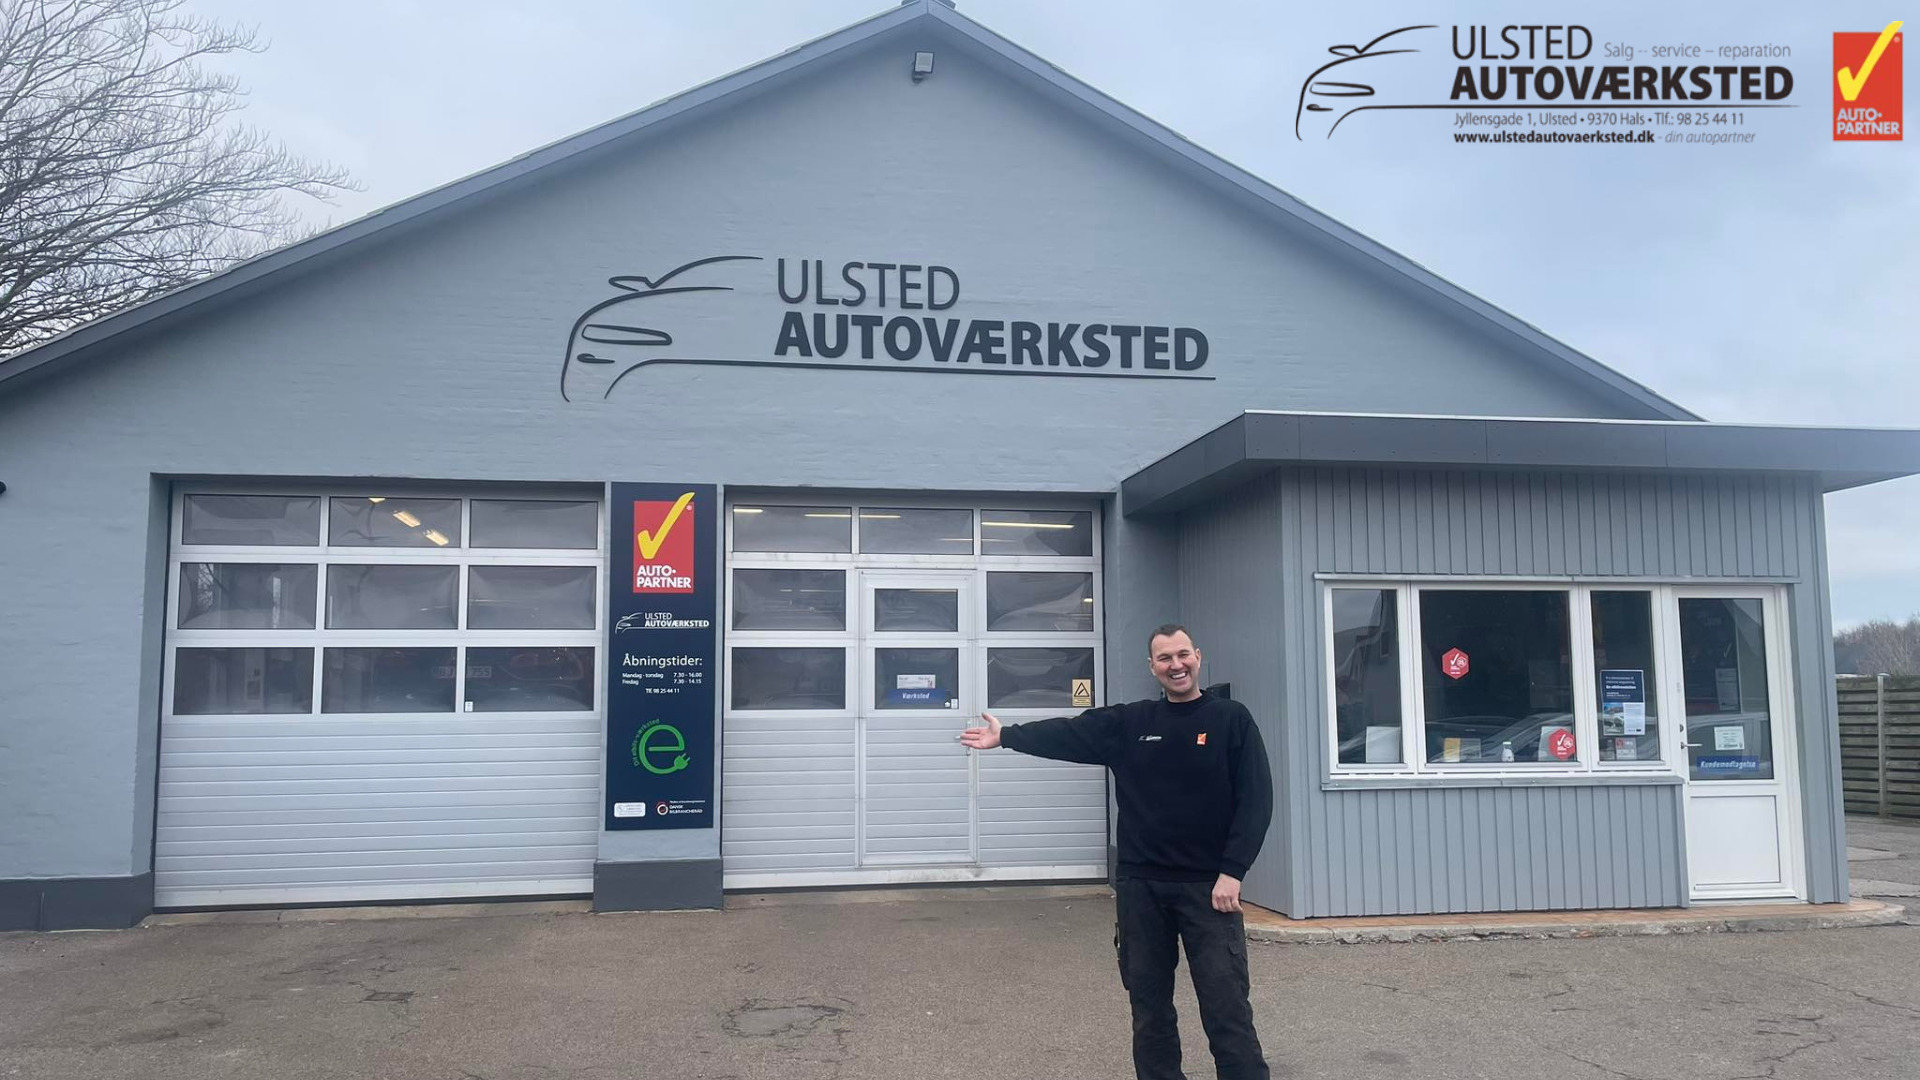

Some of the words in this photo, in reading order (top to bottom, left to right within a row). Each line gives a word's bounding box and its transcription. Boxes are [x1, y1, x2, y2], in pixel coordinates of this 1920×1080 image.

[777, 258, 960, 310] ULSTED
[774, 311, 1209, 371] AUTOVÆRKSTED
[636, 577, 692, 589] PARTNER
[645, 612, 673, 620] ULSTED
[622, 653, 703, 669] Åbningstider:
[902, 692, 930, 700] Værksted
